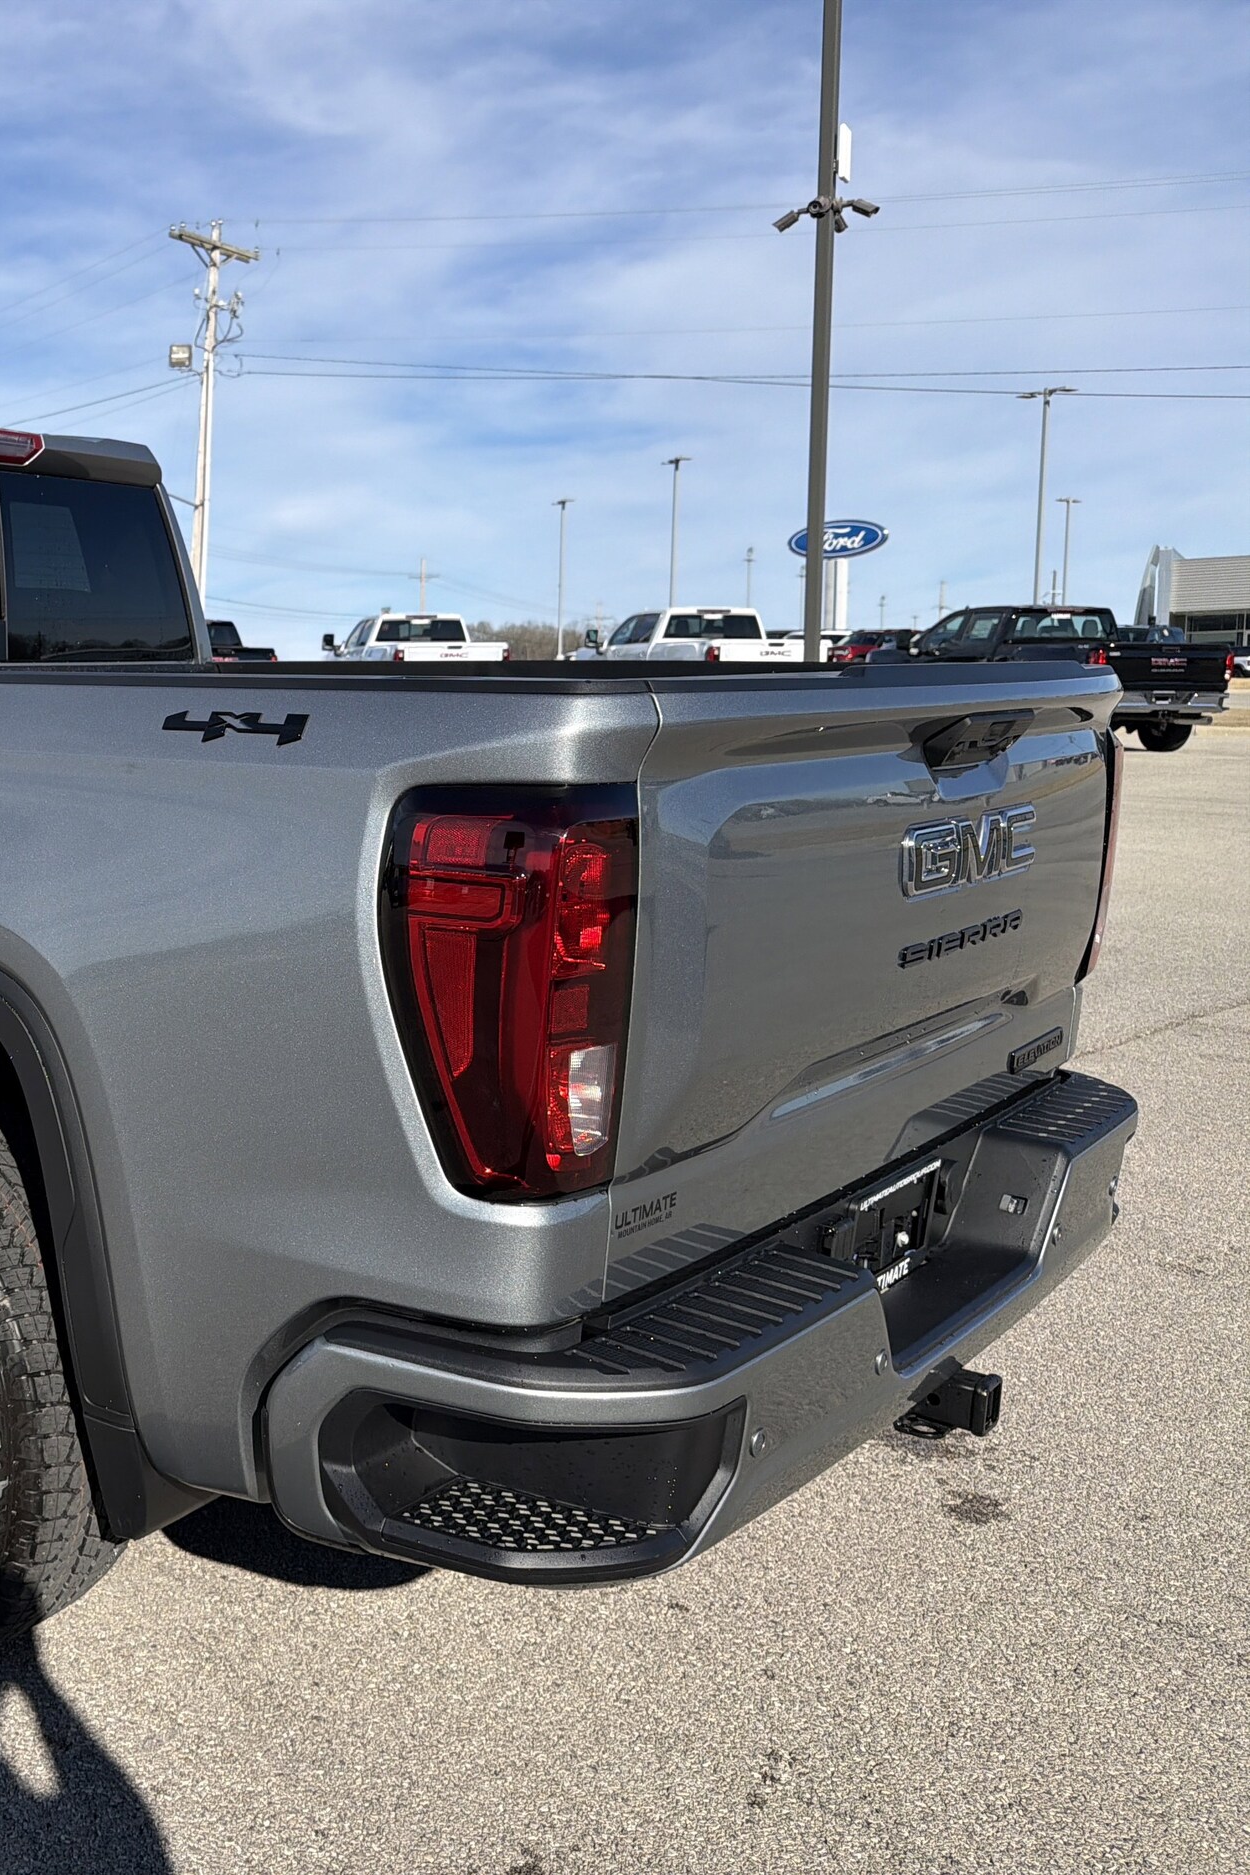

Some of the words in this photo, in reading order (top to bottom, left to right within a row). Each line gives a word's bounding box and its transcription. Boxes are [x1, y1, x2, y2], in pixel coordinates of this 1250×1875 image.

[899, 802, 1037, 900] GMC
[897, 909, 1024, 969] SIERRA
[615, 1191, 677, 1230] ULTIMATE
[877, 1257, 910, 1290] TIMATE
